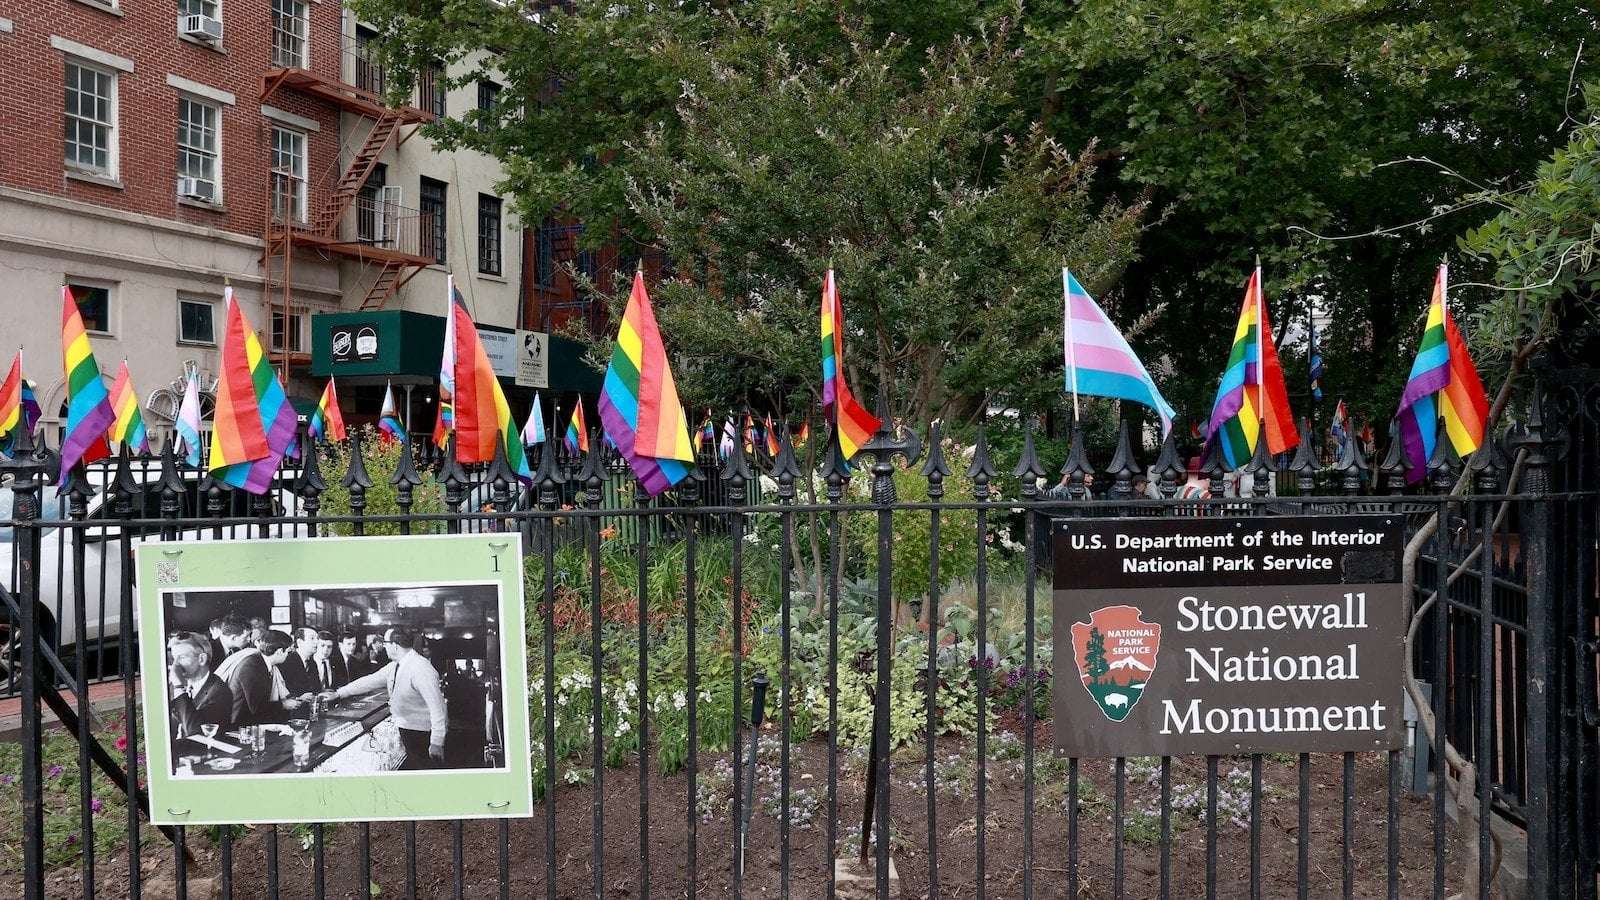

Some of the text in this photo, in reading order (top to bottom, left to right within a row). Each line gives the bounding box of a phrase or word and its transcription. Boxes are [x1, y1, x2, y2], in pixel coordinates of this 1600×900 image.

[1071, 528, 1385, 553] U.S. Department of the Interior
[491, 555, 501, 572] 1
[1122, 553, 1333, 573] National Park Service
[1176, 592, 1369, 632] Stonewall
[1107, 629, 1156, 638] NATIONAL
[1118, 637, 1144, 646] PARK
[1112, 646, 1151, 655] SERVICE
[1184, 643, 1360, 683] National
[1159, 698, 1386, 735] Monument
